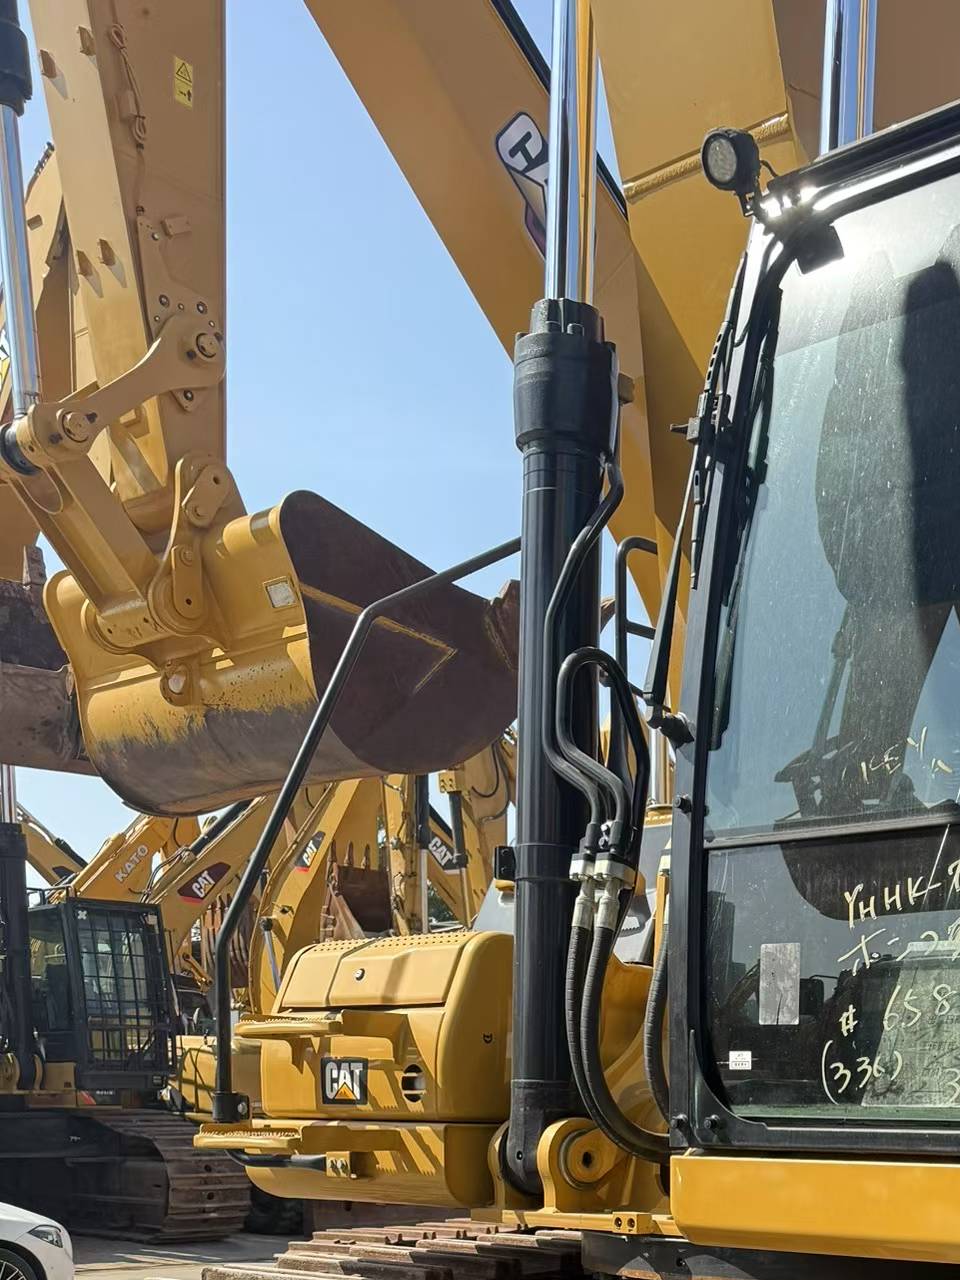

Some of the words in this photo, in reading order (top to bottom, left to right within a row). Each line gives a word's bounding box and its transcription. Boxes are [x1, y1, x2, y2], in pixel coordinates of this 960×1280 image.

[115, 844, 149, 883] KATO
[302, 839, 318, 866] CAT
[428, 836, 455, 866] CAT
[191, 869, 216, 898] CAT
[325, 1061, 364, 1101] CAT
